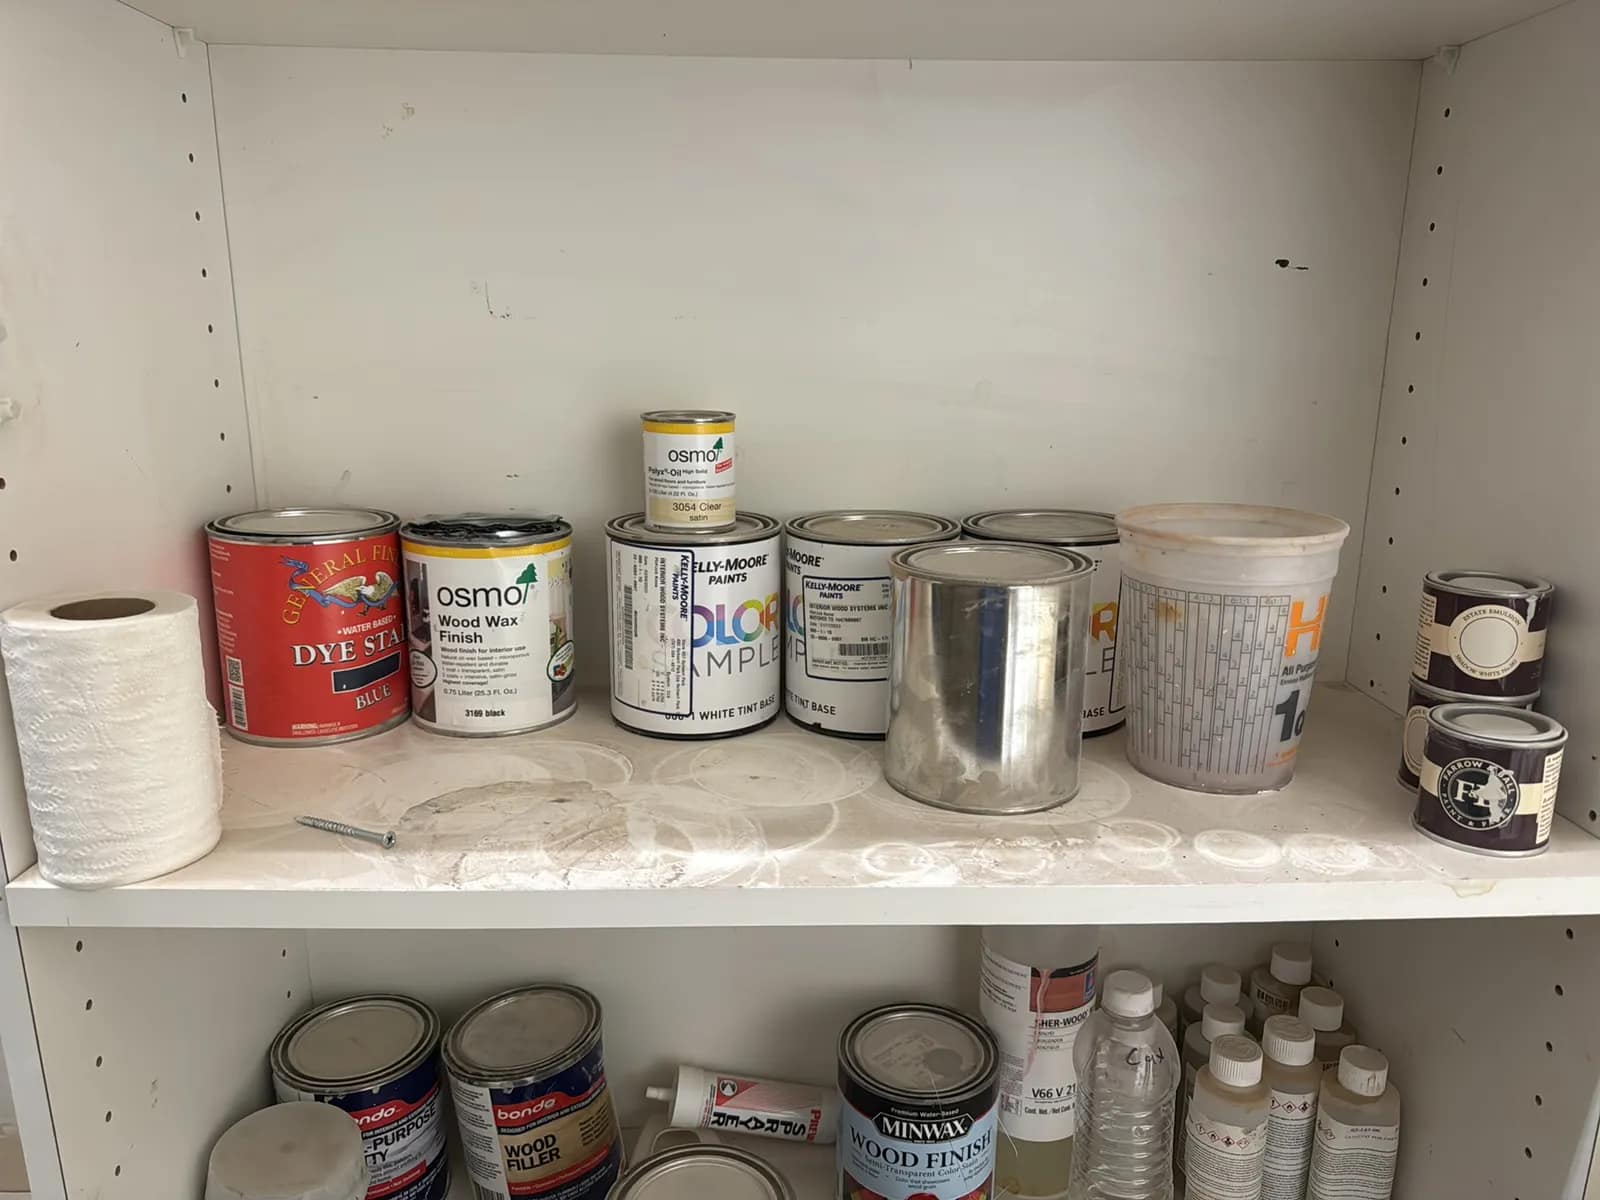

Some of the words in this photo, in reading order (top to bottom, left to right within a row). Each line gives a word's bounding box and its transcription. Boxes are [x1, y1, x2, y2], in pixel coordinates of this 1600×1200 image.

[668, 449, 716, 463] osmo
[672, 502, 697, 512] 3054
[699, 501, 722, 512] Clear
[693, 554, 769, 573] ELLY-MOORE
[281, 548, 367, 625] GENERAL
[671, 573, 681, 601] PAINTS
[680, 554, 691, 620] KELLY-MOORE
[708, 572, 748, 586] PAINTS
[805, 580, 862, 592] KELLY-MOORE
[437, 586, 523, 608] osmo
[819, 592, 844, 600] PAINTS
[342, 622, 372, 635] WATER
[372, 615, 394, 628] BASED
[437, 614, 481, 629] Wood
[484, 614, 519, 628] Wax
[693, 592, 779, 649] OLOR
[1463, 608, 1487, 622] ESTATE
[439, 630, 483, 644] Finish
[292, 637, 357, 667] DYE
[1282, 665, 1295, 677] All
[355, 683, 393, 710] BLUE
[794, 693, 810, 710] TINT
[811, 701, 837, 716] BASE
[485, 708, 506, 717] black
[700, 707, 735, 721] WHITE
[737, 702, 759, 716] TINT
[760, 694, 776, 710] BASE
[1443, 760, 1483, 781] FARROW
[1031, 1087, 1054, 1099] V66
[1055, 1086, 1064, 1097] V
[355, 1107, 396, 1125] ndo
[497, 1098, 556, 1121] bondo
[890, 1107, 919, 1117] Premium
[919, 1108, 960, 1118] Water-Based
[882, 1116, 966, 1140] MINWAX
[504, 1133, 557, 1158] WOOD
[849, 1124, 920, 1168] WOOD
[926, 1127, 993, 1169] FINISH
[507, 1147, 561, 1172] FILLER
[864, 1154, 936, 1178] Semi-Transparent
[937, 1166, 960, 1177] Color
